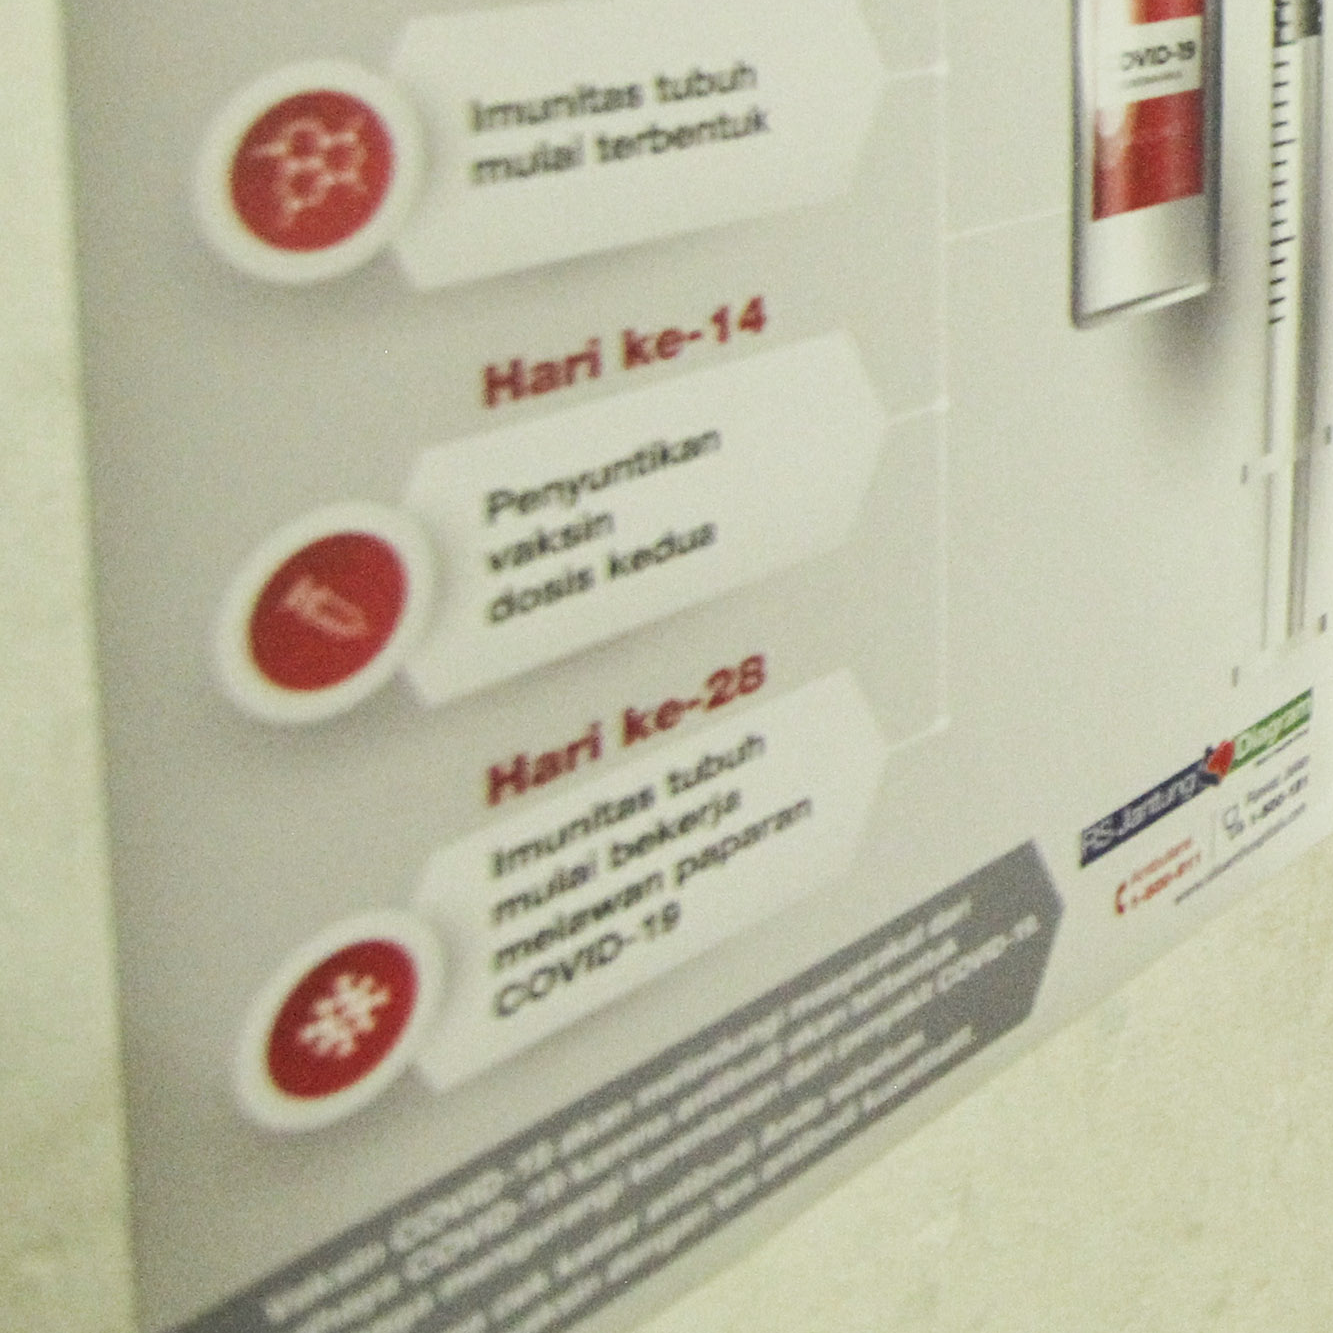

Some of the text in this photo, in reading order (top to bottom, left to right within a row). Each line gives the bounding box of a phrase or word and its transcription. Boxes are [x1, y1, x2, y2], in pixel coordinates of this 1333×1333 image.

[470, 60, 759, 134] Imunitas tubuh
[471, 105, 771, 187] mulai terbentuk
[482, 295, 767, 410] Hari ke-14
[485, 429, 722, 527] Penyuntikan
[486, 512, 615, 573] vaksin
[486, 522, 718, 626] dosis kedua
[486, 653, 767, 808] Hari ke-28
[491, 733, 766, 878] Imunitas tubuh
[491, 789, 743, 925] mulai bekerja
[492, 798, 813, 971] melawan paparan
[495, 902, 682, 1019] COVID-19
